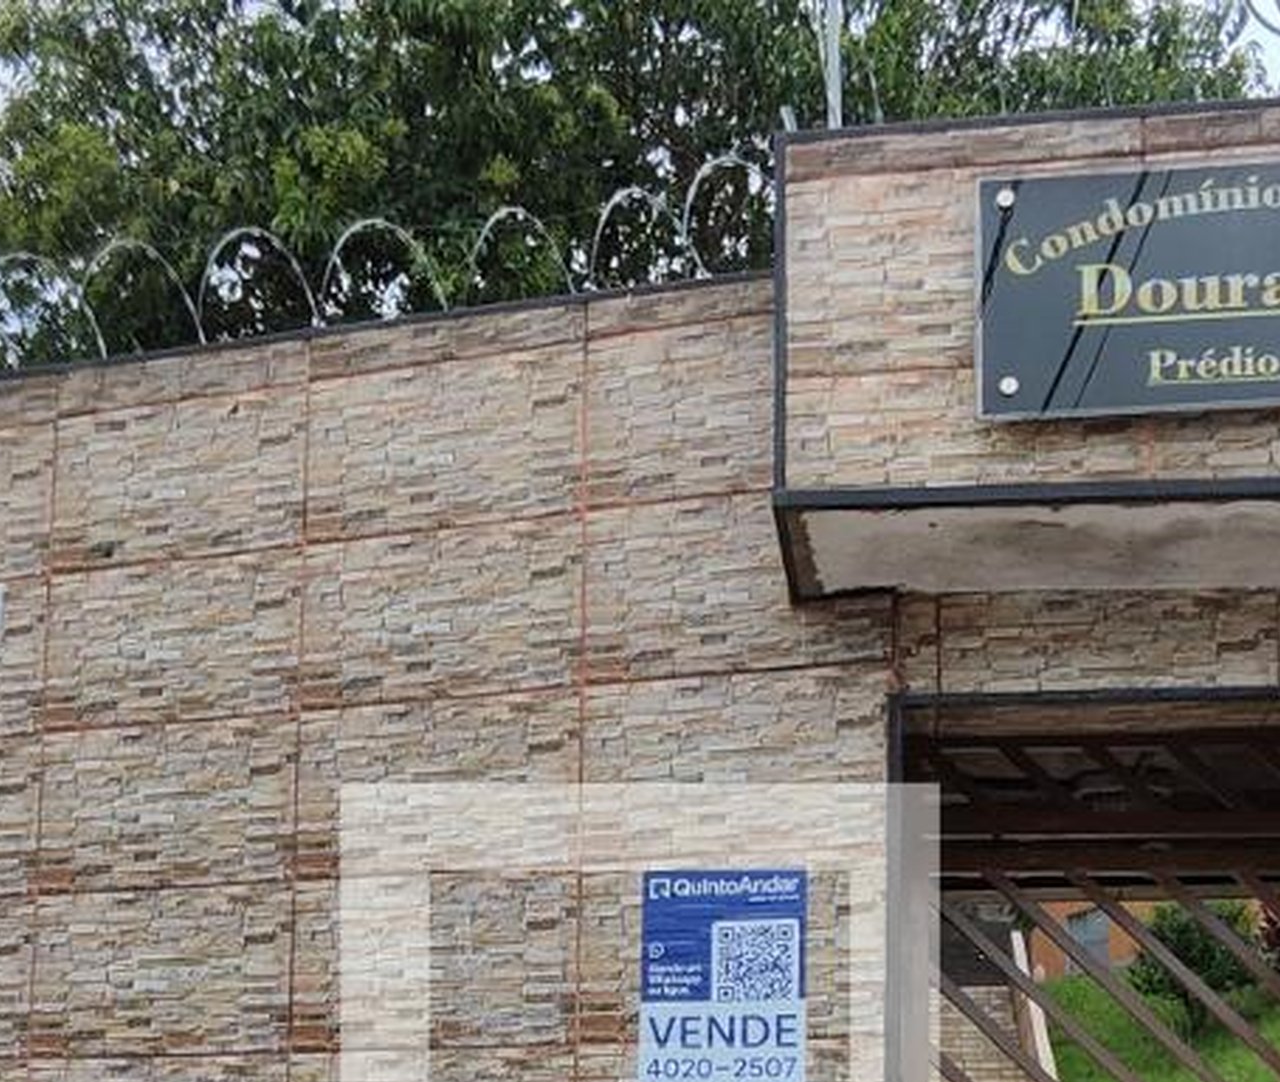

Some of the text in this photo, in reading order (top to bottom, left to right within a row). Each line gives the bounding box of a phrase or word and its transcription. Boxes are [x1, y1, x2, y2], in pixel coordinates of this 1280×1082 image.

[1148, 341, 1280, 383] Prédio
[672, 875, 800, 897] QuintoAndar
[648, 1013, 799, 1050] VENDE
[646, 1056, 798, 1079] 4020-2507
